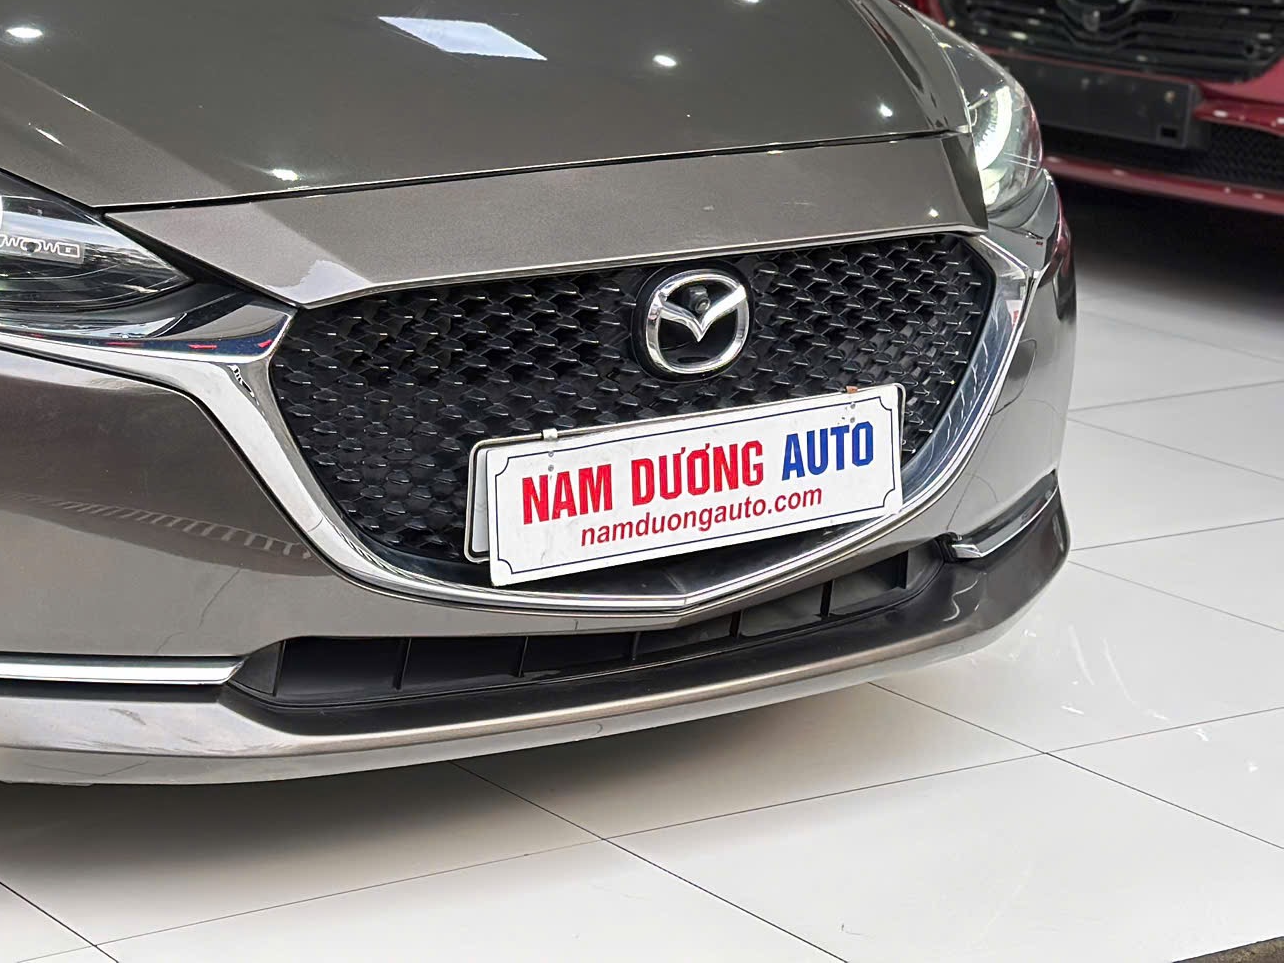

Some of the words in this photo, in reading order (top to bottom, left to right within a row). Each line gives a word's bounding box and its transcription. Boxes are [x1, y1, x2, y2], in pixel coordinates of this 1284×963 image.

[522, 464, 613, 525] NAM
[631, 440, 764, 506] DƯƠNG
[781, 421, 874, 481] AUTO
[580, 487, 823, 547] namduongauto.com
